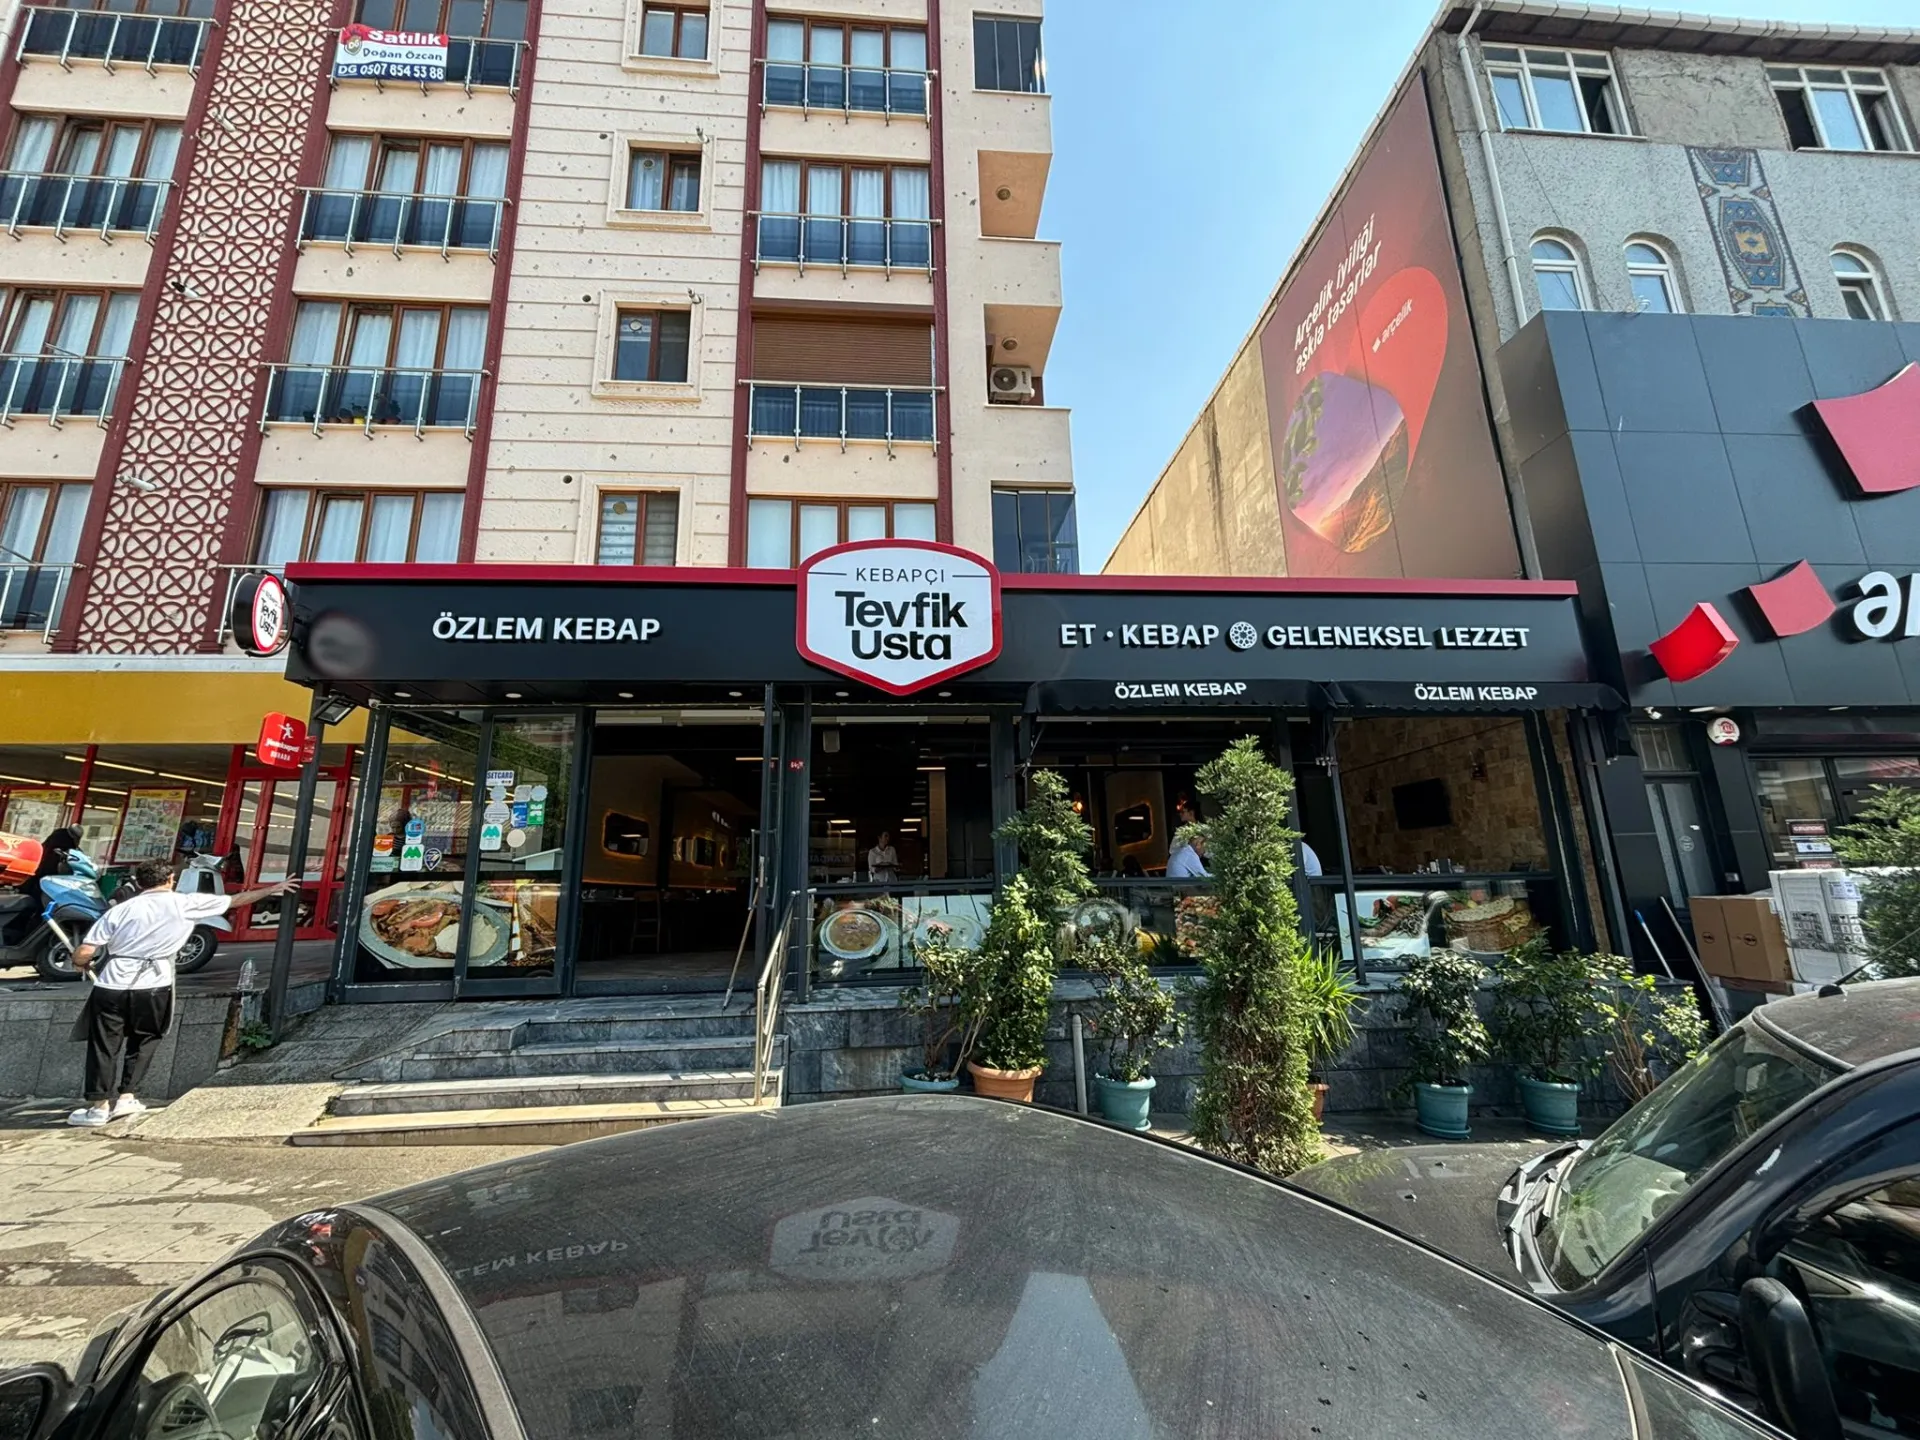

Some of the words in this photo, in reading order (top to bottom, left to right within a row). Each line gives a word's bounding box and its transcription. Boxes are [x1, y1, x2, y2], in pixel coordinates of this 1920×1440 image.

[363, 48, 402, 58] Doğan
[405, 51, 443, 61] Özcan
[338, 65, 358, 74] DG
[360, 63, 388, 75] 0507
[413, 65, 427, 78] 53
[429, 67, 444, 80] 88
[1295, 279, 1334, 351] Arçelik
[1336, 213, 1375, 290] iyiliği
[1296, 324, 1324, 374] aşkla
[1327, 240, 1382, 330] tasarlar
[1382, 299, 1413, 343] arçelik
[856, 568, 945, 585] KEBAPÇI
[835, 591, 968, 628] Tevfik
[432, 612, 543, 640] ÖZLEM
[553, 617, 660, 640] KEBAP
[1061, 624, 1096, 645] ET
[1121, 624, 1220, 645] KEBAP
[1267, 626, 1432, 647] GELENEKSEL
[1441, 627, 1530, 647] LEZZET
[852, 630, 952, 660] Usta
[1114, 682, 1180, 699] ÖZLEM
[1184, 681, 1247, 696] KEBAP
[1414, 683, 1473, 701] ÖZLEM
[1478, 686, 1538, 701] KEBAP
